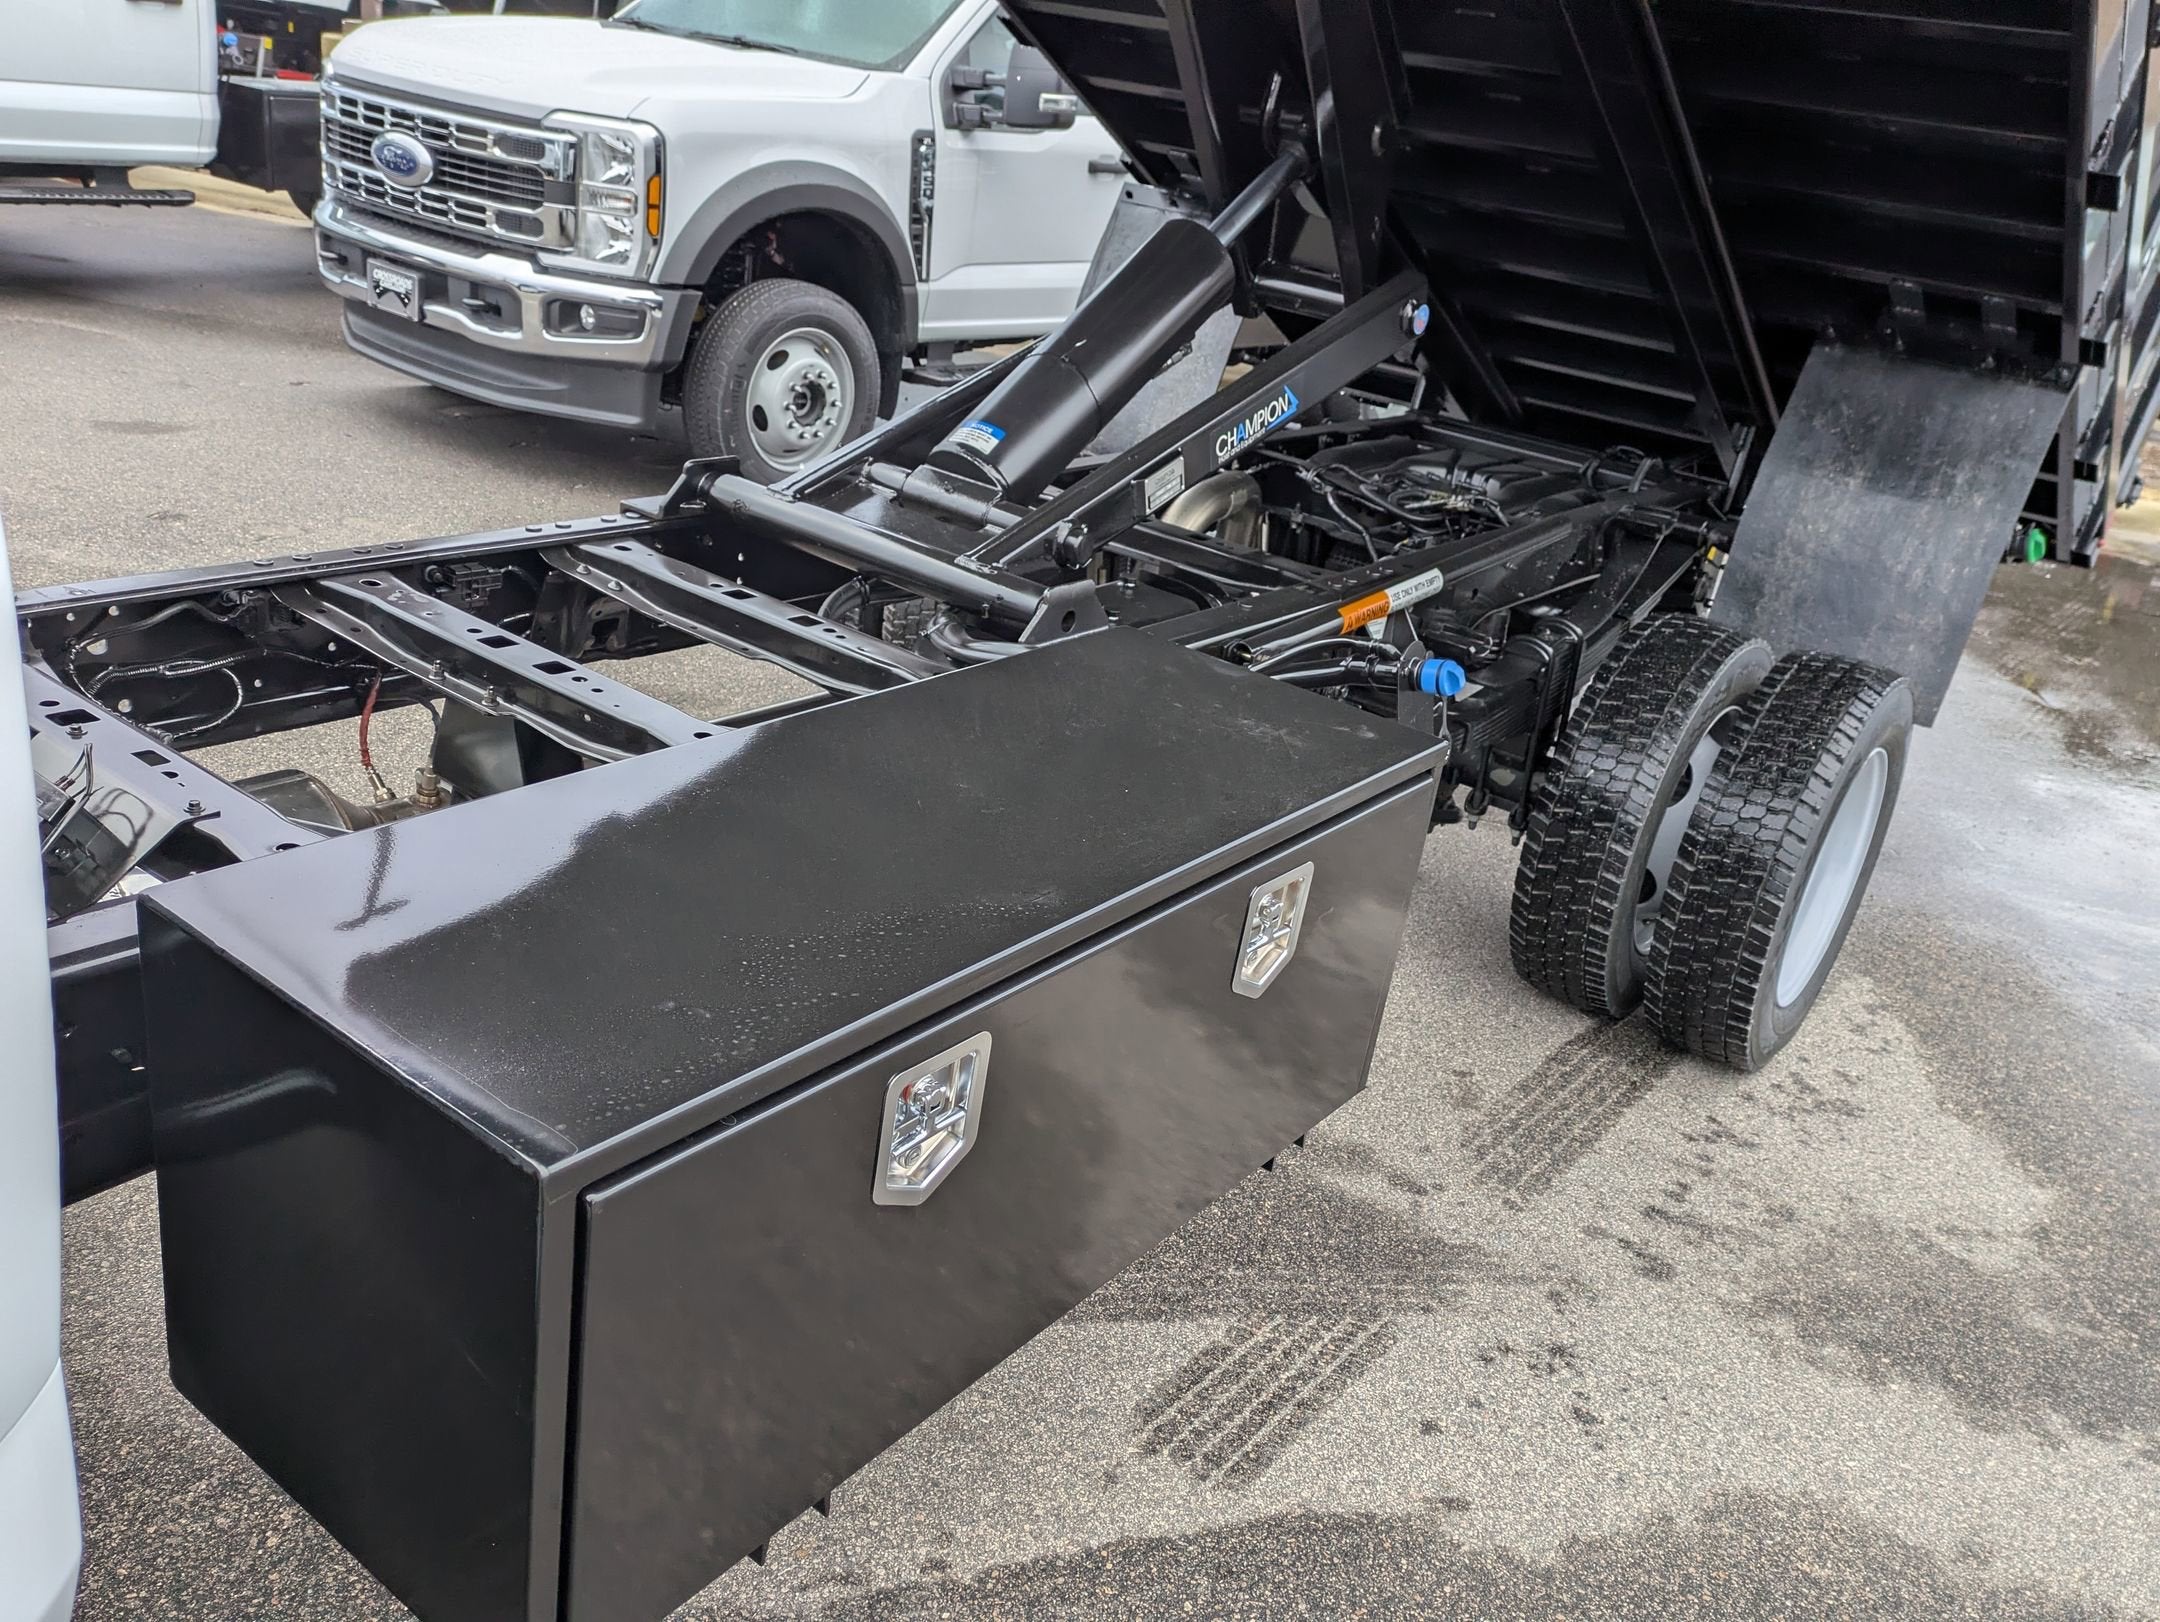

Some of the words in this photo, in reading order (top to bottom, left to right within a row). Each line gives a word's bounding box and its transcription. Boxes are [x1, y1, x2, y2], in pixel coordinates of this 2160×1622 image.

[1215, 393, 1289, 457] CHAMPION
[1391, 589, 1403, 602] USE
[1402, 586, 1414, 599] ONLY
[1354, 600, 1390, 624] WARNING
